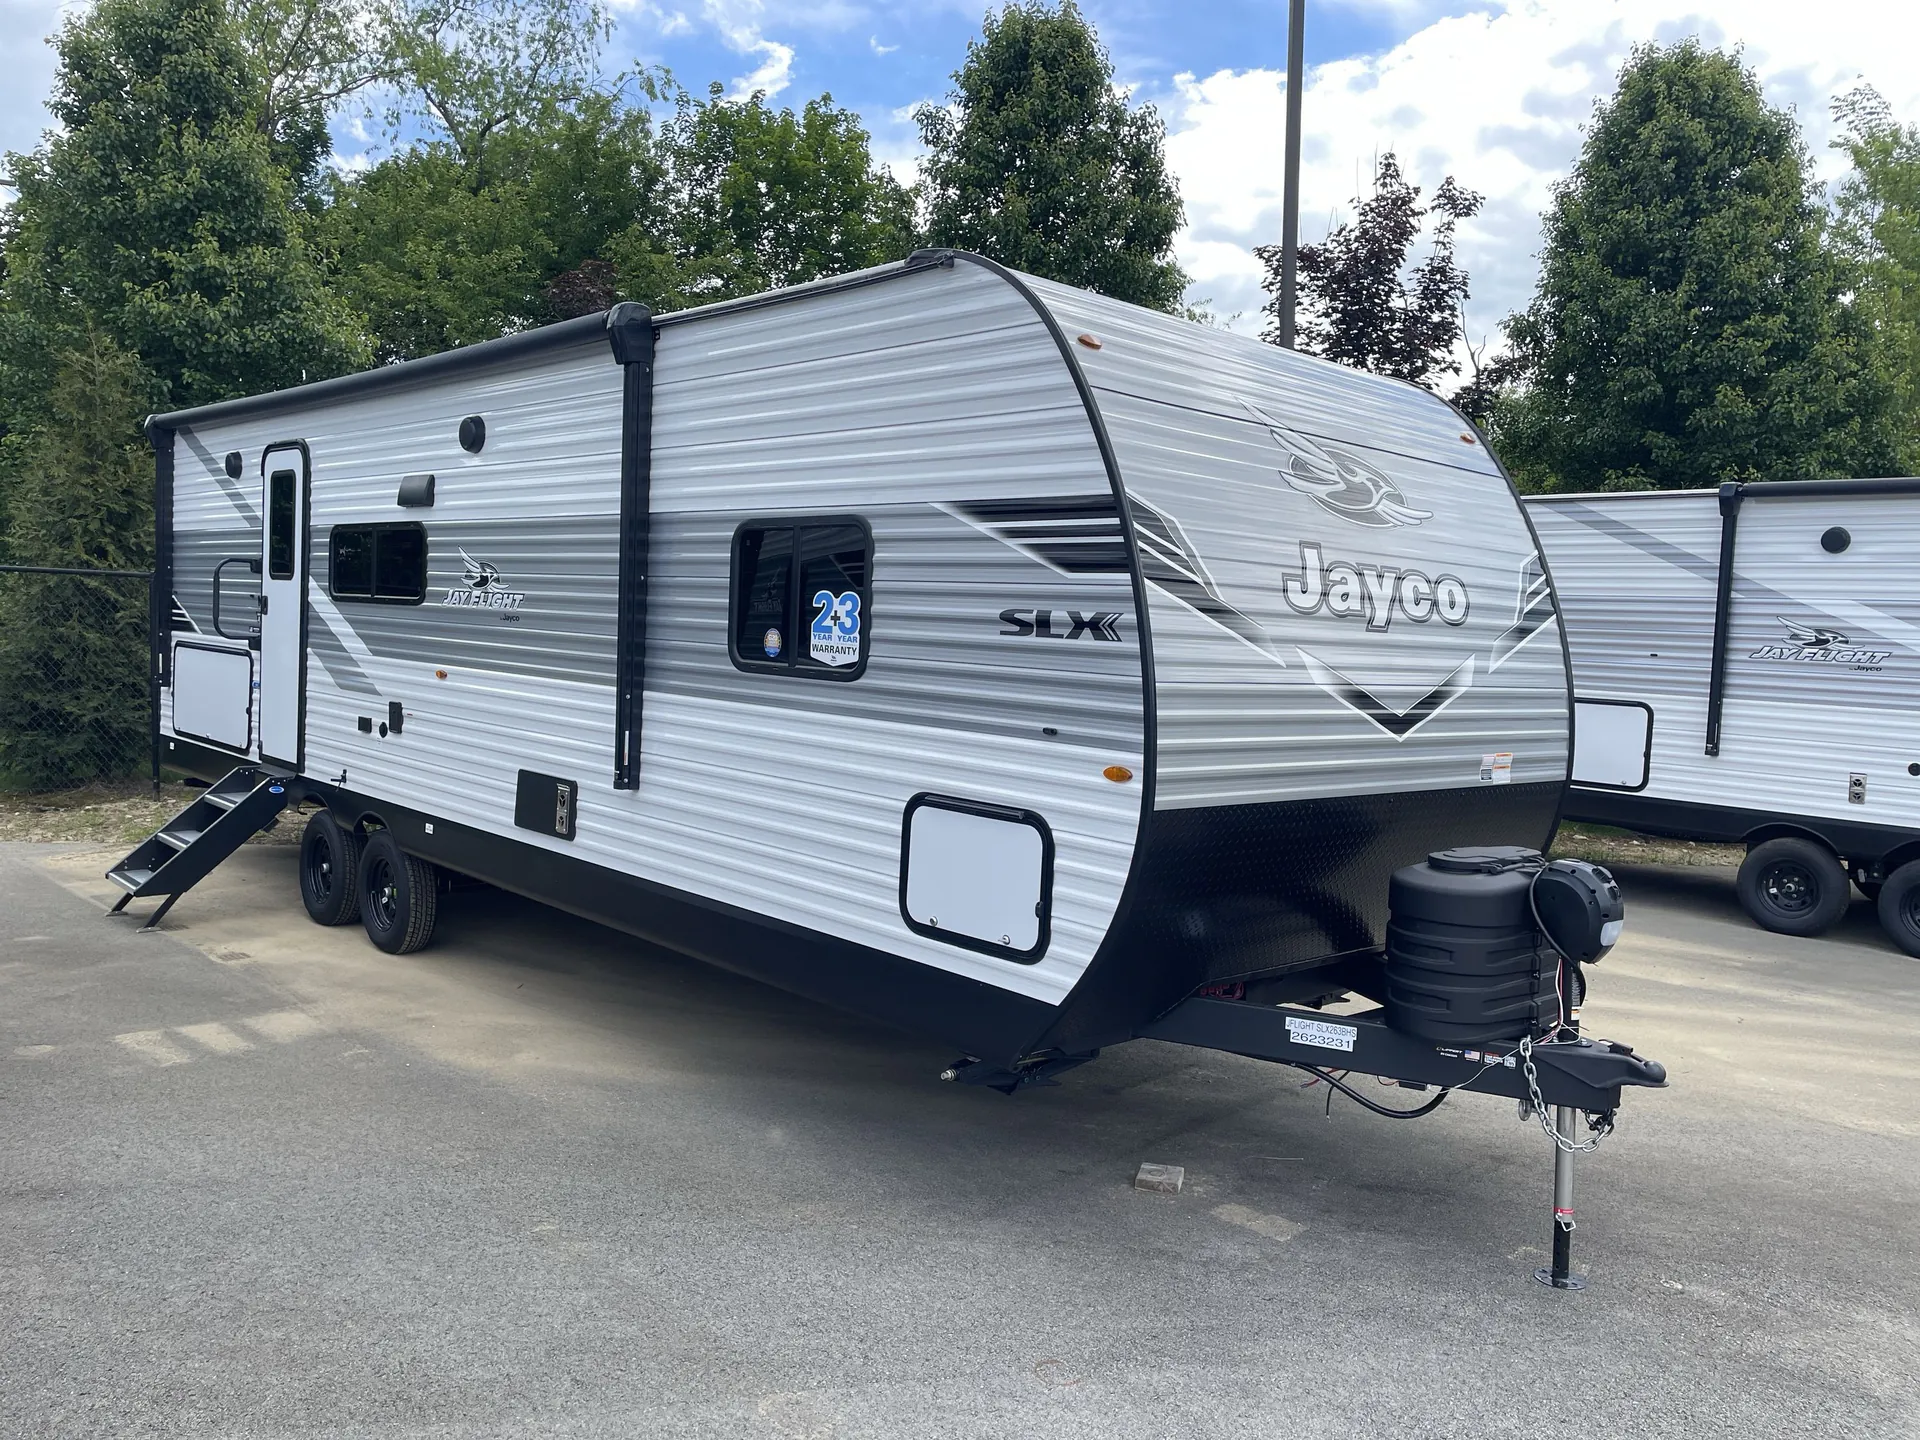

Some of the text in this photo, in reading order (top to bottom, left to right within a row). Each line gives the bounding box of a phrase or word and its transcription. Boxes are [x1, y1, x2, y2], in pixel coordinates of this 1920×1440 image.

[1282, 540, 1470, 633] Jayco
[442, 589, 525, 611] JAY FLIGHT
[999, 609, 1124, 642] SLX
[812, 633, 833, 642] YEAR
[837, 635, 858, 643] YEAR
[812, 643, 857, 656] WARRANTY
[1749, 645, 1893, 664] JAY FLIGHT
[1316, 1023, 1357, 1038] SLX263BHS
[1291, 1031, 1351, 1049] 2623231
